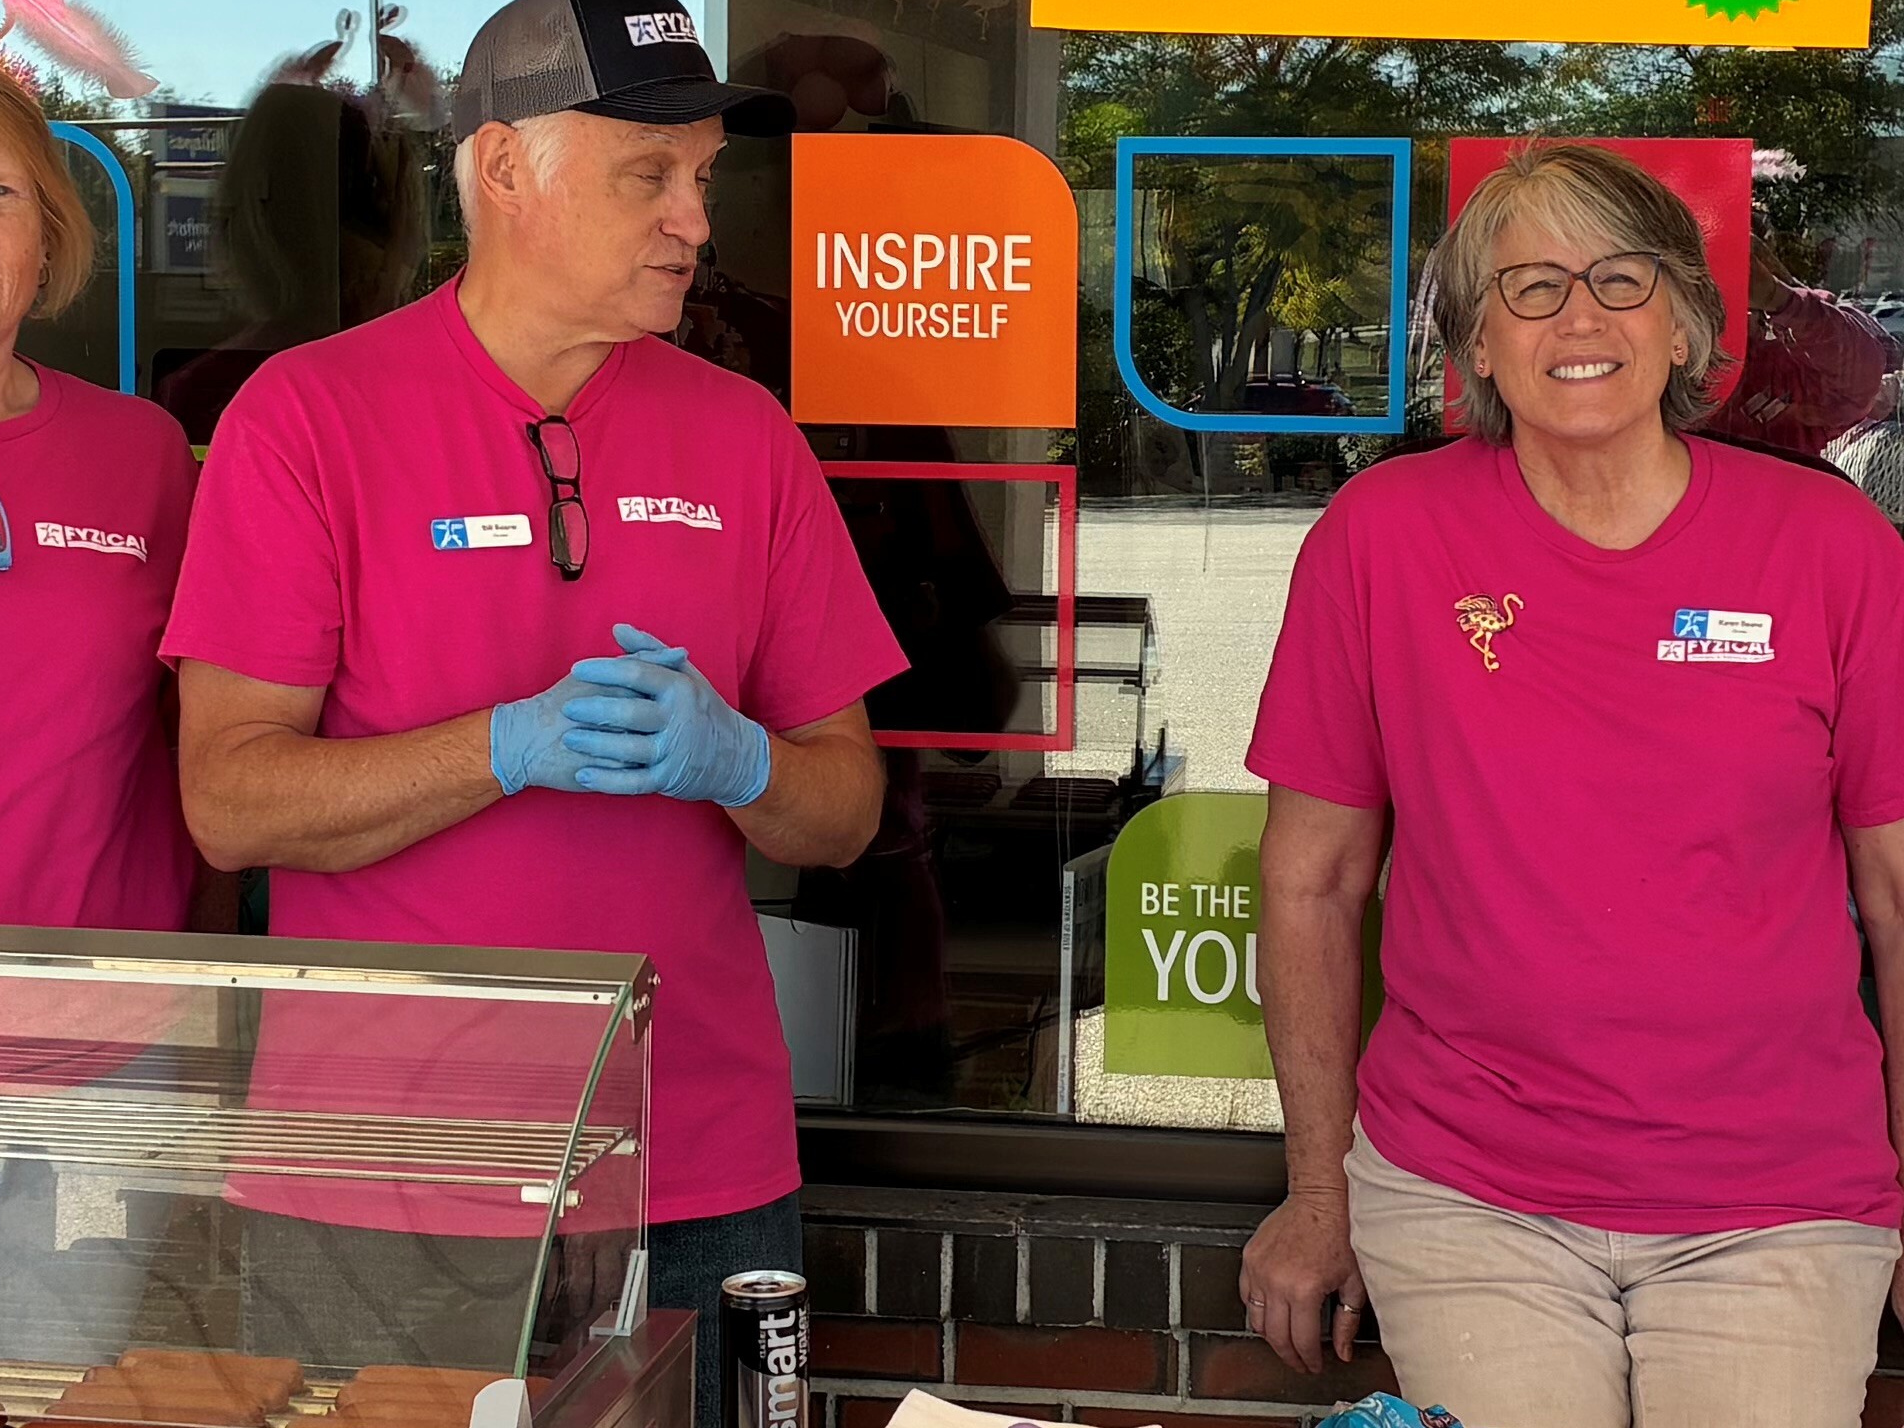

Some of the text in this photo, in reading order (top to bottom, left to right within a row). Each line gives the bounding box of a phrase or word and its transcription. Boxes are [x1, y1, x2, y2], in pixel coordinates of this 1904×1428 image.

[815, 231, 1032, 293] INSPIRE
[834, 301, 1009, 340] YOURSELF
[648, 496, 722, 523] FYZICAL
[1141, 882, 1251, 919] BE THE
